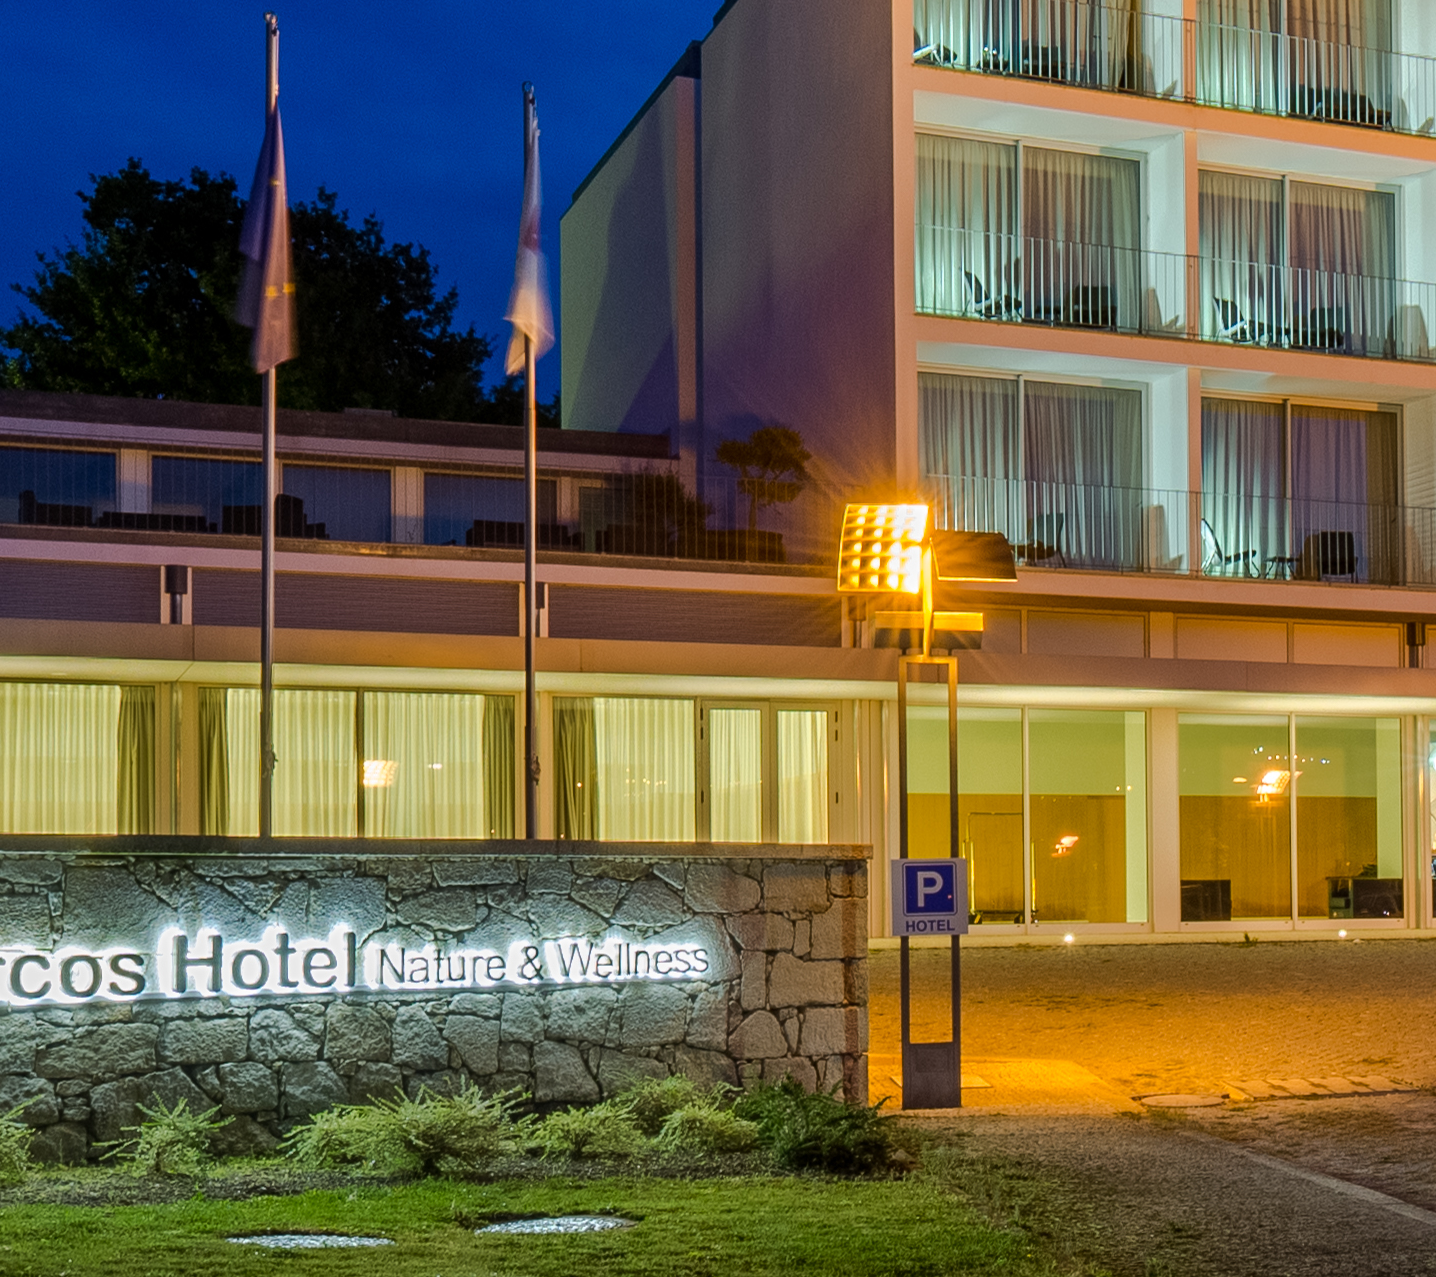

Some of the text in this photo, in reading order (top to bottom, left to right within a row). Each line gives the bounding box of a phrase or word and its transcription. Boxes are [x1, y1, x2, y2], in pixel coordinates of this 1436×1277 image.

[917, 871, 944, 908] P
[905, 919, 956, 933] HOTEL
[172, 931, 356, 994] Hotel
[379, 947, 506, 984] Nature
[520, 944, 545, 981] &
[558, 941, 710, 979] Wellness
